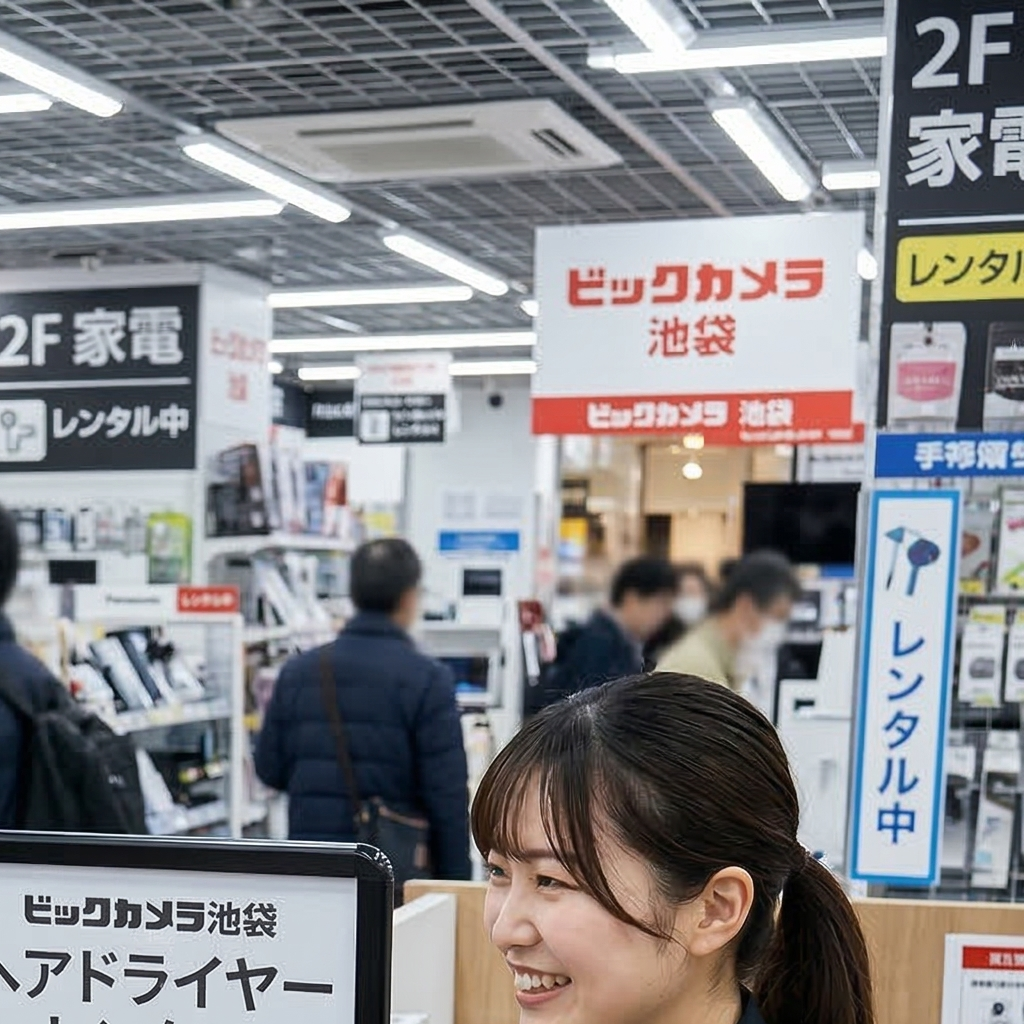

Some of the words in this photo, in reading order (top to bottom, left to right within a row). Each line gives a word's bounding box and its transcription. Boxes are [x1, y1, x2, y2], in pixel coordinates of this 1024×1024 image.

[912, 12, 1014, 89] 2F
[567, 258, 826, 308] ビックカメラ
[72, 306, 184, 367] 家電
[648, 315, 737, 358] 池袋
[52, 405, 190, 441] レンタル中
[587, 400, 729, 429] ビックカメラ
[876, 621, 925, 845] レンタル中
[24, 894, 278, 939] ビックカメラ池袋
